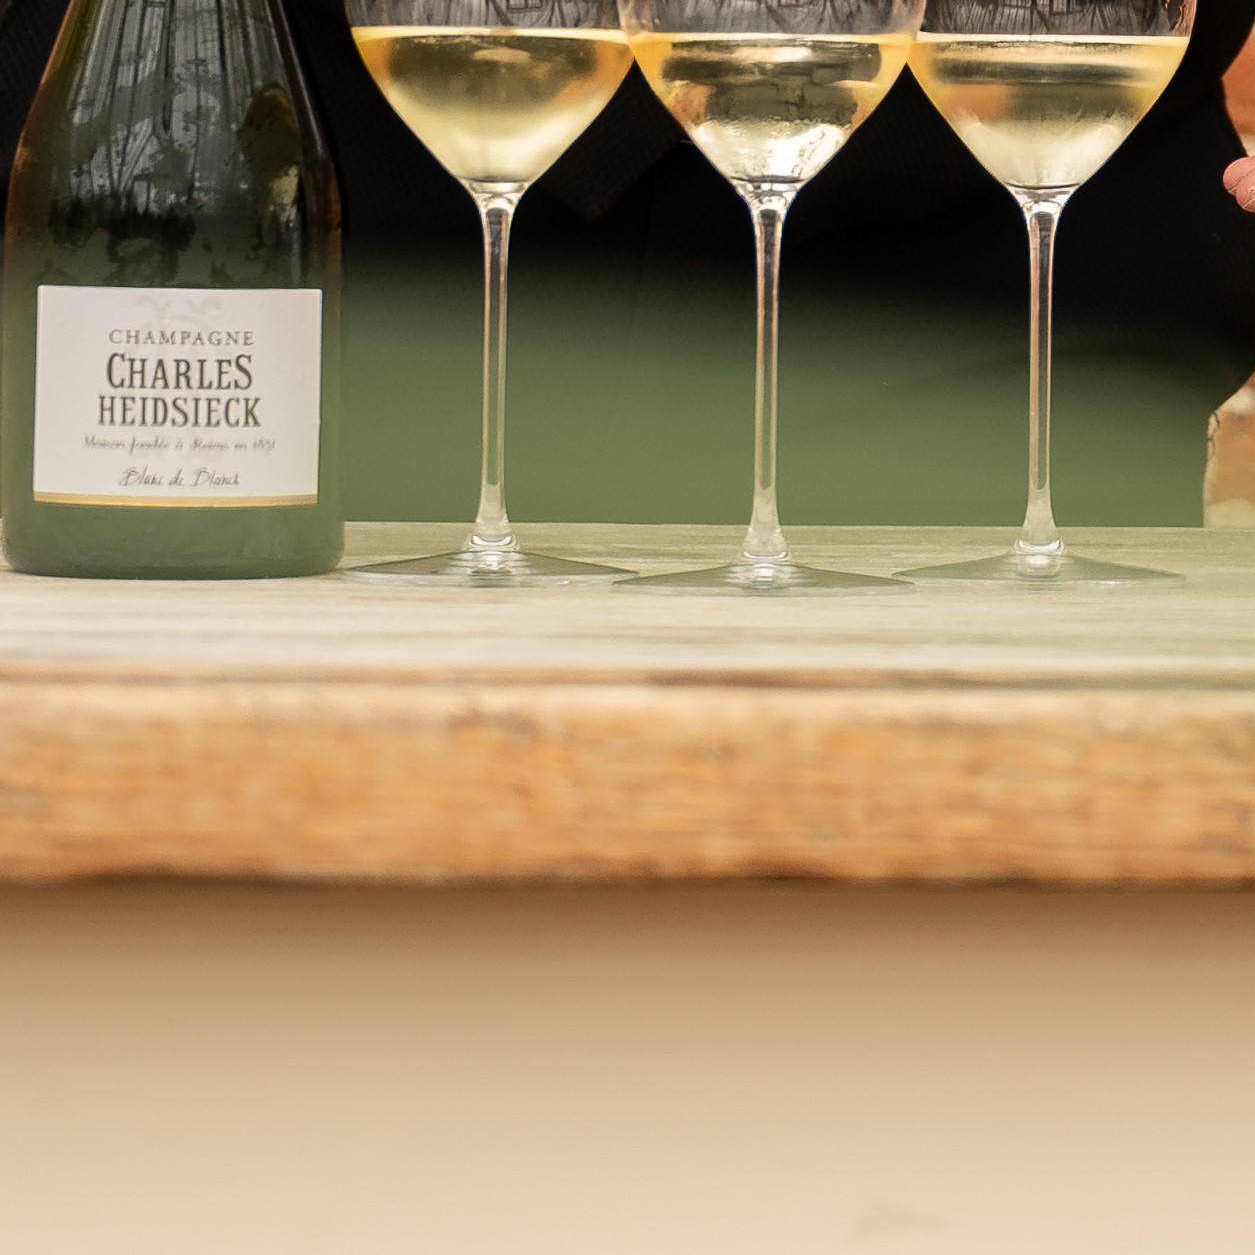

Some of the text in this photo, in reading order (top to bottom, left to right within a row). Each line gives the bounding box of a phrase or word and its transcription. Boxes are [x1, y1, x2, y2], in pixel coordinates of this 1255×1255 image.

[108, 329, 255, 346] CHAMPAGNE
[106, 352, 253, 390] CHARLES
[97, 395, 262, 428] HEIDSIECK
[118, 465, 164, 487] Blanc
[168, 469, 185, 487] de
